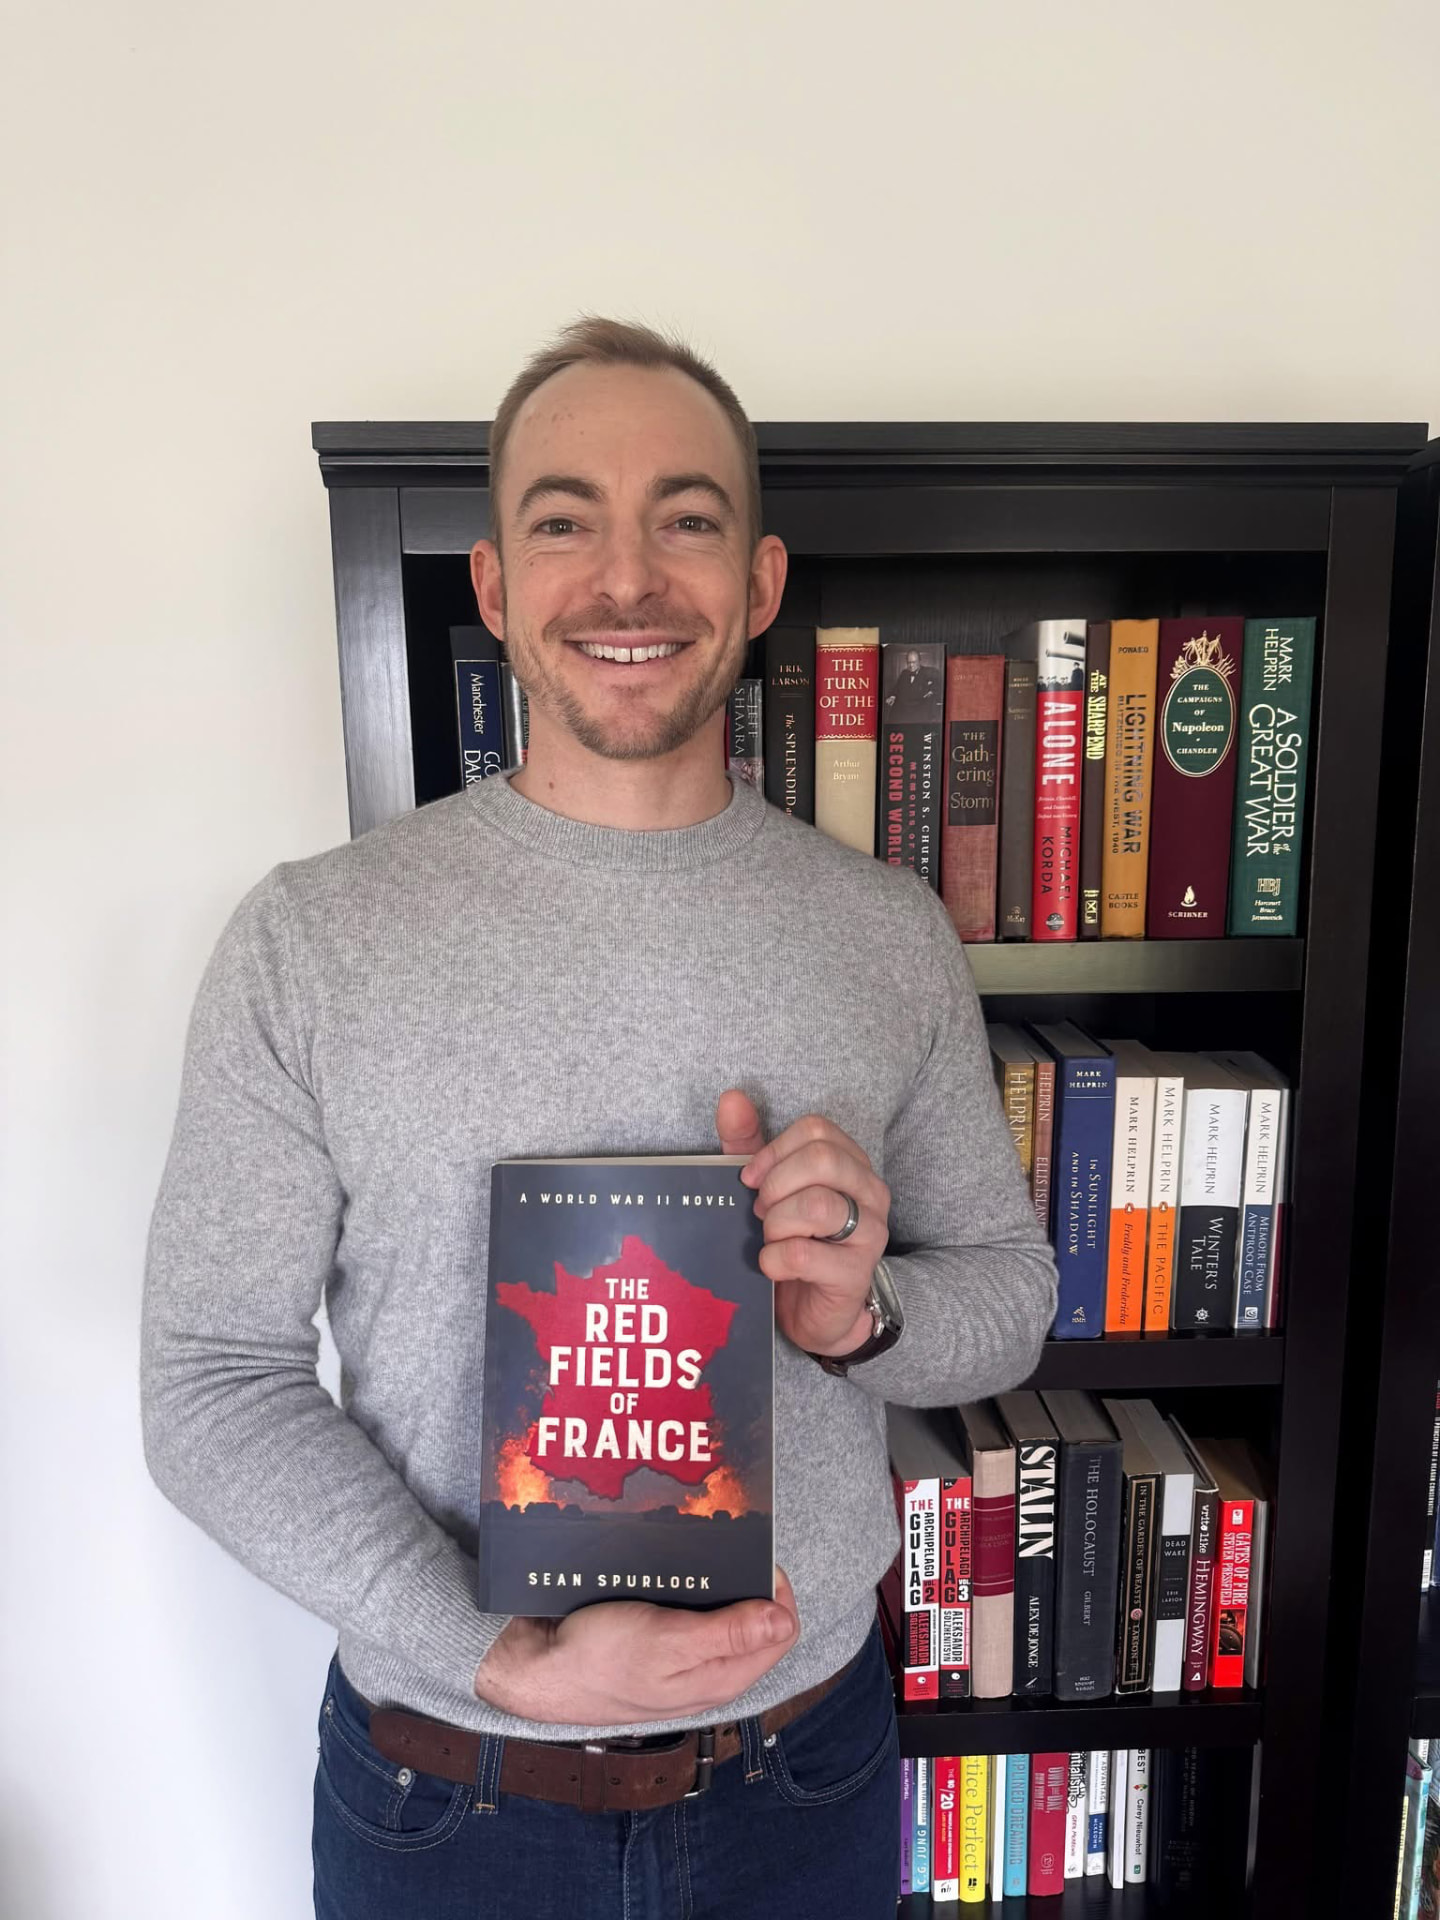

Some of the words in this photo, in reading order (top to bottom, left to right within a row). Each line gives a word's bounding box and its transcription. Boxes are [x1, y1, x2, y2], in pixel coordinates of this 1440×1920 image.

[780, 665, 803, 673] ERIK
[832, 659, 864, 672] THE
[1262, 628, 1280, 692] HELPRIN
[1278, 637, 1295, 684] MARK
[772, 677, 810, 686] LARSON
[824, 677, 870, 690] TURN
[1090, 670, 1099, 693] THE
[1098, 674, 1107, 689] AT
[471, 673, 487, 734] Manchester
[819, 695, 841, 709] OF
[844, 695, 875, 708] THE
[1087, 696, 1107, 737] SHARP
[1177, 696, 1223, 704] CAMPAIGNS
[734, 688, 745, 755] SHAARA
[747, 704, 758, 738] JEFF
[829, 713, 866, 726] TIDE
[1172, 721, 1225, 735] Napoleon
[1276, 707, 1299, 729] A
[963, 732, 986, 741] THE
[1041, 701, 1078, 787] ALONE
[1086, 736, 1105, 760] END
[1123, 694, 1147, 803] LIGHTNING
[1176, 747, 1218, 755] CHANDLER
[1248, 703, 1277, 787] GREAT
[785, 733, 797, 806] SPLENDID
[833, 759, 860, 769] Arthur
[888, 733, 905, 801] SECOND
[922, 733, 933, 800] WINSTON
[951, 743, 996, 765] Gath-
[833, 772, 860, 784] Bryant
[908, 761, 918, 826] MEMOIRS
[956, 766, 995, 787] ering
[1271, 733, 1302, 841] SOLDIER
[922, 806, 931, 819] S.
[950, 791, 994, 809] Storm
[887, 808, 904, 866] WORLD
[908, 833, 916, 848] OF
[1111, 833, 1120, 854] 1940
[1122, 809, 1143, 854] WAR
[1245, 797, 1271, 858] WAR
[1041, 836, 1054, 894] KORDA
[1059, 826, 1072, 902] MICHAEL
[1167, 911, 1209, 919] SCRIBNER
[1008, 1072, 1027, 1146] HELPRIN
[1038, 1072, 1052, 1122] HELPRIN
[1163, 1086, 1176, 1127] MARK
[1128, 1096, 1140, 1133] MARK
[1208, 1103, 1221, 1142] MARK
[1258, 1101, 1272, 1141] MARK
[1036, 1156, 1049, 1185] ELLIS
[1071, 1151, 1080, 1173] AND
[1126, 1137, 1138, 1193] HELPRIN
[1159, 1132, 1173, 1193] HELPRIN
[1205, 1146, 1217, 1194] HELPRIN
[1255, 1145, 1270, 1193] HELPRIN
[520, 1193, 528, 1203] A
[540, 1193, 598, 1205] WORLD
[610, 1194, 645, 1206] WAR
[656, 1195, 670, 1206] II
[682, 1195, 736, 1207] NOVEL
[1086, 1173, 1102, 1249] SUNLIGHT
[1068, 1190, 1083, 1256] SHADOW
[1121, 1223, 1134, 1255] Freddy
[1157, 1222, 1168, 1250] THE
[1245, 1212, 1258, 1266] ANTPROOF
[1257, 1215, 1271, 1260] MEMOIR
[1121, 1257, 1131, 1275] and
[1190, 1235, 1208, 1271] TALE
[1204, 1216, 1224, 1290] WINTER'S
[605, 1278, 649, 1300] THE
[1152, 1257, 1165, 1315] PACIFIC
[1243, 1267, 1252, 1295] CASE
[1255, 1260, 1267, 1292] FROM
[1119, 1277, 1130, 1325] Fredericka
[585, 1303, 668, 1344] RED
[549, 1345, 703, 1390] FIELDS
[609, 1393, 639, 1415] OF
[536, 1417, 712, 1462] FRANCE
[1432, 1422, 1440, 1450] PRINCIPLES
[1087, 1456, 1102, 1485] THE
[910, 1499, 934, 1511] THE
[945, 1498, 970, 1510] THE
[1018, 1446, 1057, 1560] STALIN
[1138, 1497, 1146, 1517] THE
[1139, 1485, 1147, 1496] IN
[1427, 1482, 1436, 1516] CONSERVATIVE
[1082, 1489, 1099, 1577] HOLOCAUST
[1200, 1504, 1209, 1531] write
[924, 1512, 935, 1577] ARCHIPELAGO
[959, 1510, 970, 1576] ARCHIPELAGO
[1136, 1518, 1145, 1556] GARDEN
[1199, 1532, 1209, 1554] like
[1222, 1532, 1235, 1561] STEVEN
[1235, 1532, 1251, 1567] GATES
[909, 1513, 921, 1606] GULAG
[944, 1511, 957, 1604] GULAG
[1135, 1558, 1143, 1571] OF
[1233, 1566, 1250, 1581] OF
[528, 1572, 583, 1586] SEAN
[597, 1574, 710, 1590] SPURLOCK
[925, 1587, 935, 1603] 2
[958, 1585, 969, 1602] 3
[1132, 1573, 1142, 1605] BEASTS
[1220, 1563, 1234, 1606] PRESSFIELD
[1231, 1580, 1249, 1606] FIRE
[1029, 1595, 1040, 1622] ALEX
[1082, 1591, 1092, 1626] GILBERT
[1191, 1560, 1211, 1656] HEMINGWAY
[909, 1612, 918, 1666] SOLZHENITSYN
[918, 1612, 929, 1665] ALEKSANDR
[943, 1610, 952, 1662] SOLZHENITSYN
[952, 1611, 963, 1662] ALEKSANDR
[1028, 1623, 1039, 1636] DE
[1130, 1624, 1139, 1659] LARSON
[1027, 1637, 1039, 1668] JONGE
[1047, 1767, 1065, 1787] OWN
[1069, 1753, 1083, 1797] ntialism
[1137, 1749, 1146, 1774] BEST
[940, 1779, 956, 1810] 80/20
[1135, 1798, 1144, 1821] Carey
[917, 1829, 927, 1859] JUNG
[964, 1804, 984, 1872] Perfect
[1009, 1808, 1025, 1865] DREAMING
[917, 1862, 927, 1886] C.G.
